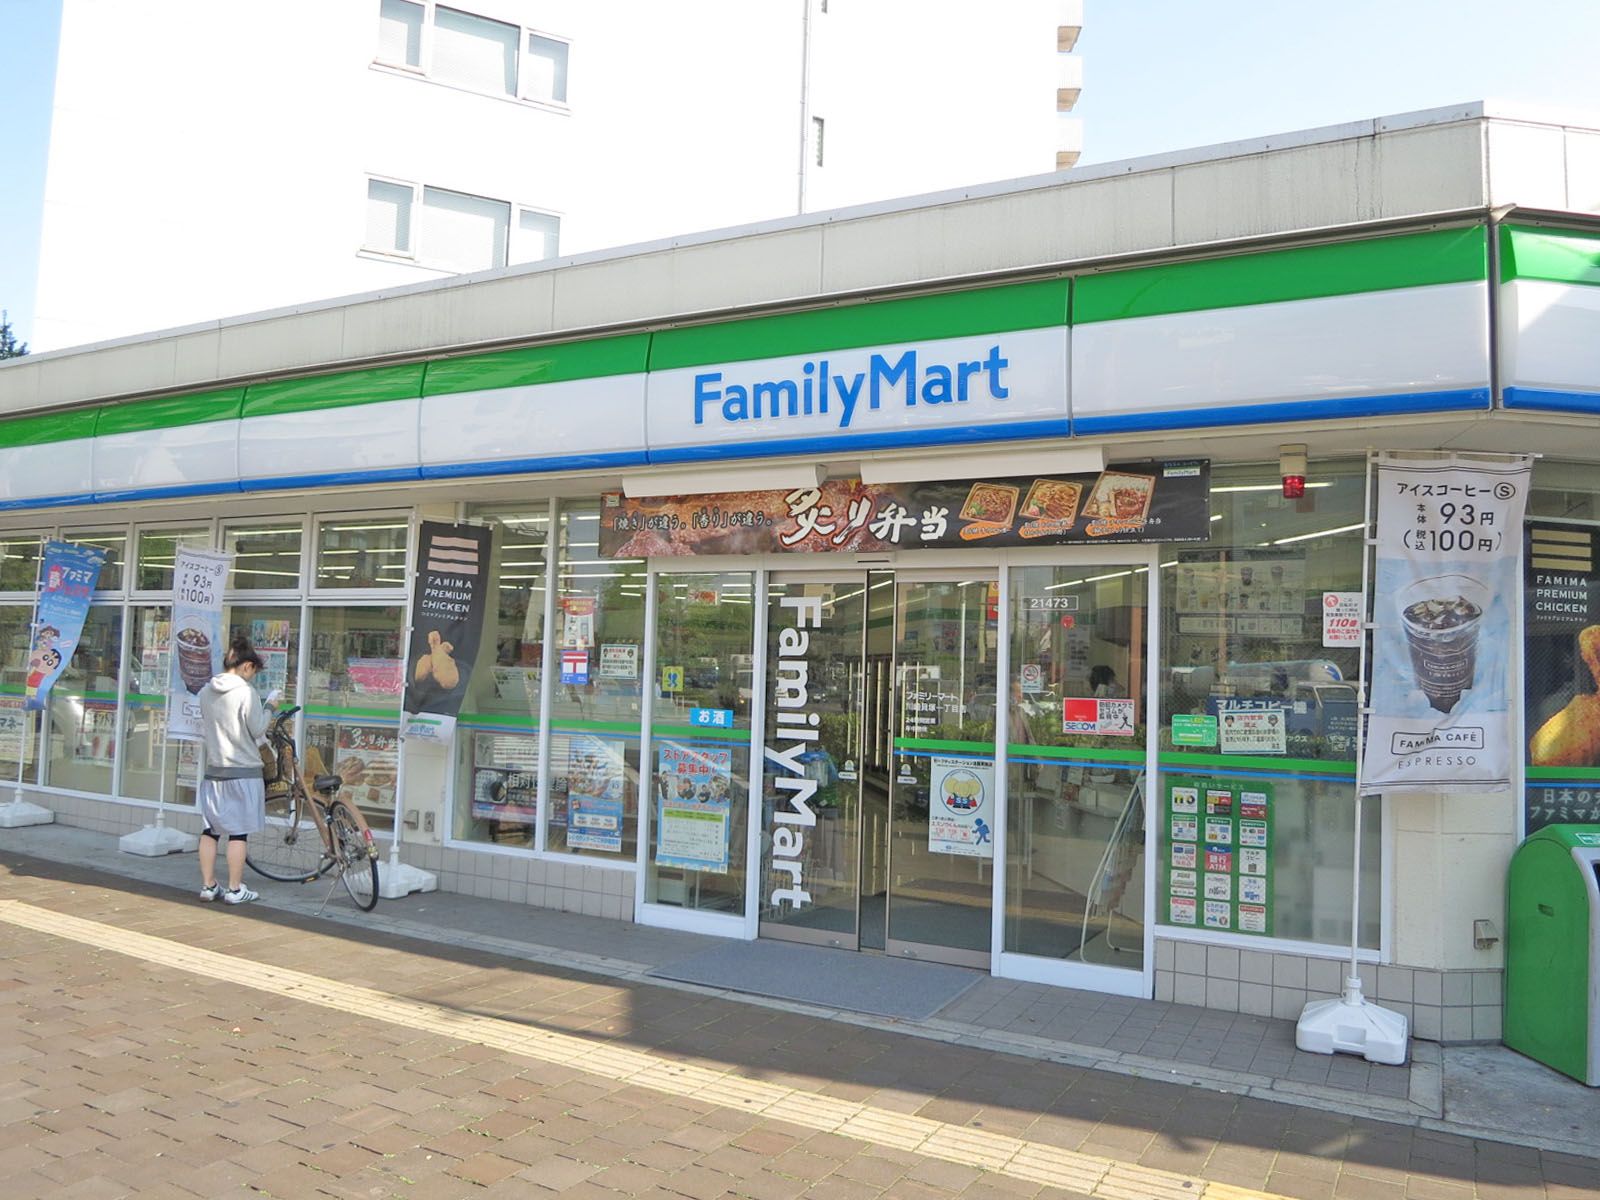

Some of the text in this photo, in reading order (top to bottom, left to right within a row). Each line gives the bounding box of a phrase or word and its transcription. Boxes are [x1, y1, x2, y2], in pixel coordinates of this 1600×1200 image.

[694, 345, 1008, 427] FamilyMart
[1397, 483, 1490, 497] アイスコーヒー
[1440, 503, 1494, 525] 93円
[181, 561, 214, 573] アイスコーヒー
[427, 576, 473, 589] FAMIMA
[1536, 575, 1587, 587] FAMIMA
[424, 588, 472, 601] PREMIUM
[1536, 589, 1588, 600] PREMIUM
[422, 600, 470, 613] CHICKEN
[1031, 597, 1069, 609] 21473
[1535, 602, 1588, 614] CHICKEN
[698, 710, 725, 725] お酒
[1065, 722, 1096, 731] SECOM
[1399, 731, 1477, 748] FAMIMA CAFÉ
[765, 596, 823, 910] FamilyMart
[1398, 756, 1476, 769] ESPRESSO
